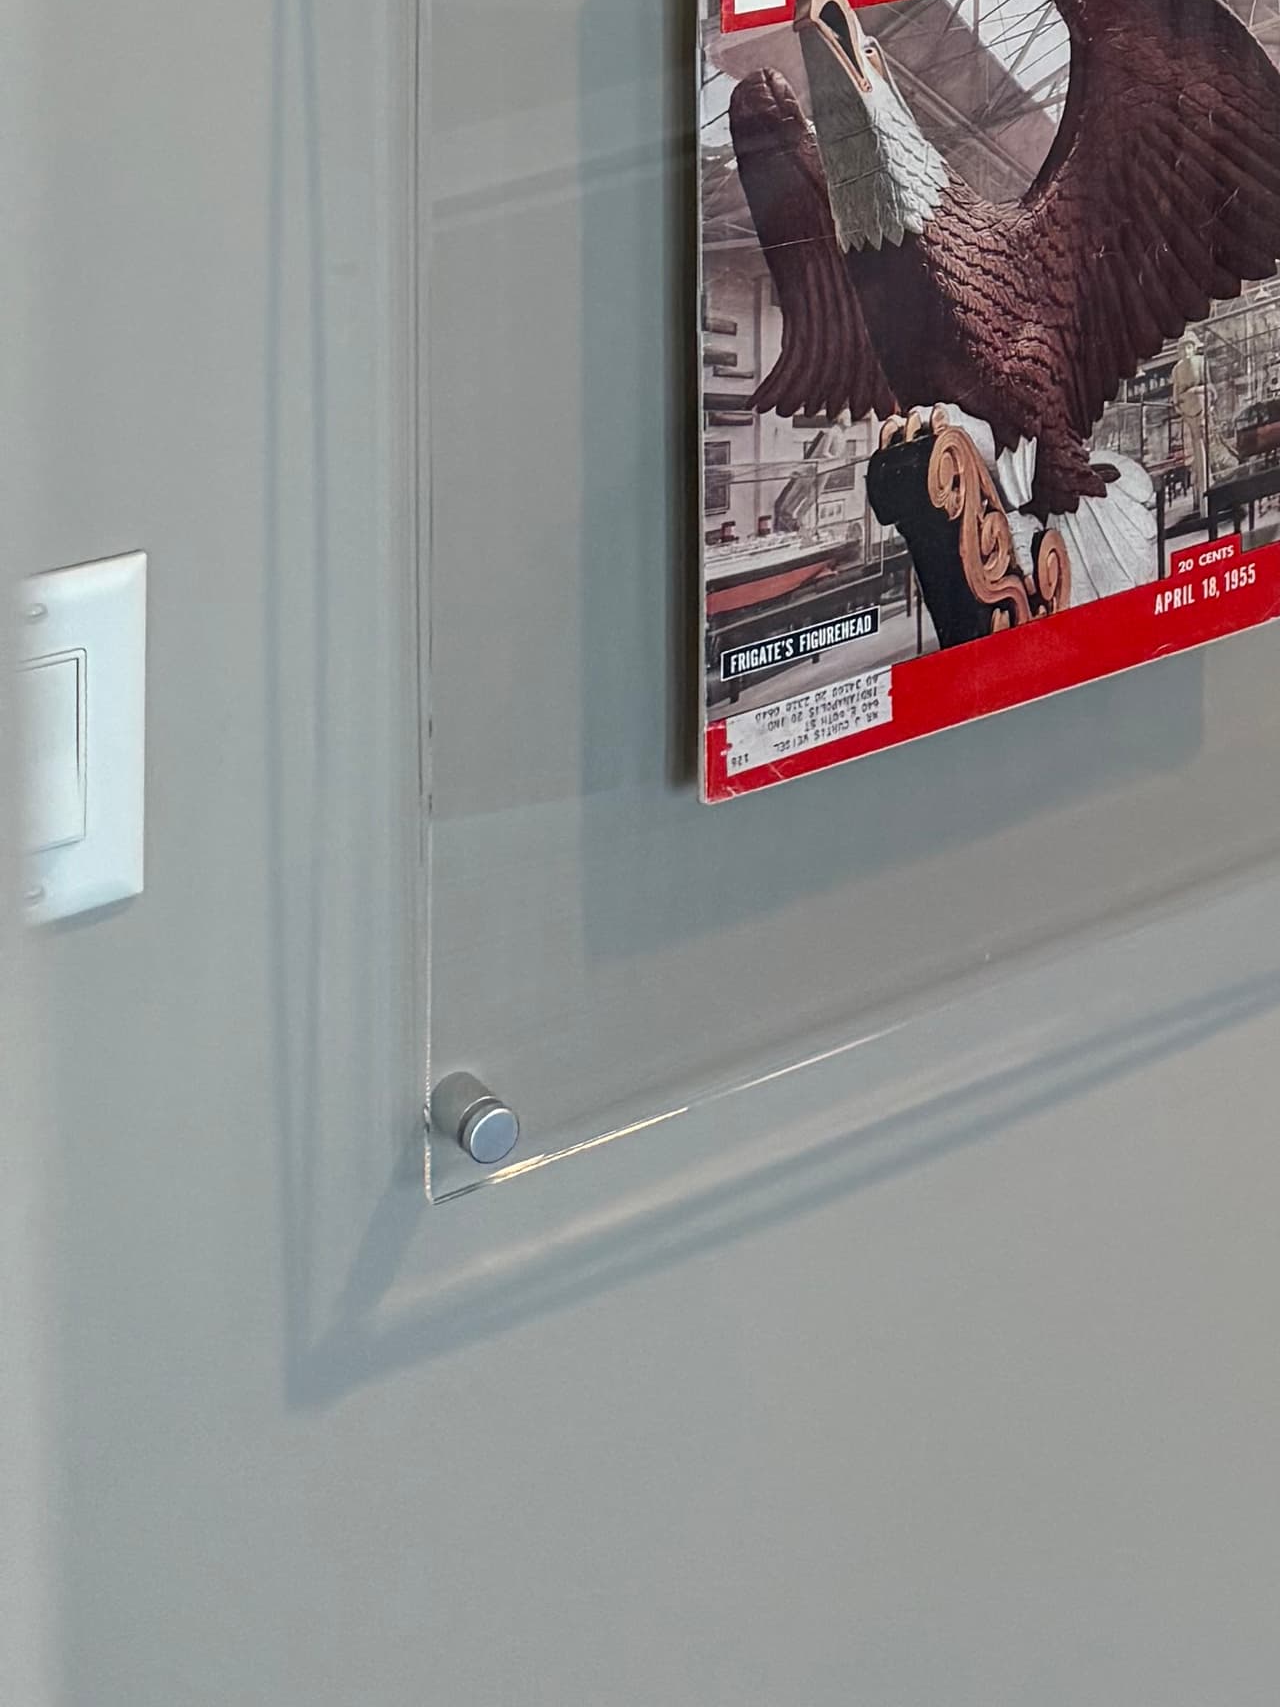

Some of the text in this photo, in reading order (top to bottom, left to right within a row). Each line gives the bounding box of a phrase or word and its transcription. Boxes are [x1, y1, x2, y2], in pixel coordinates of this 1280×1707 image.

[1178, 545, 1234, 573] 20 CENTS
[1154, 563, 1255, 615] APRIL 18, 1955
[730, 615, 871, 674] FRIGATE'S FIGUREHEAD
